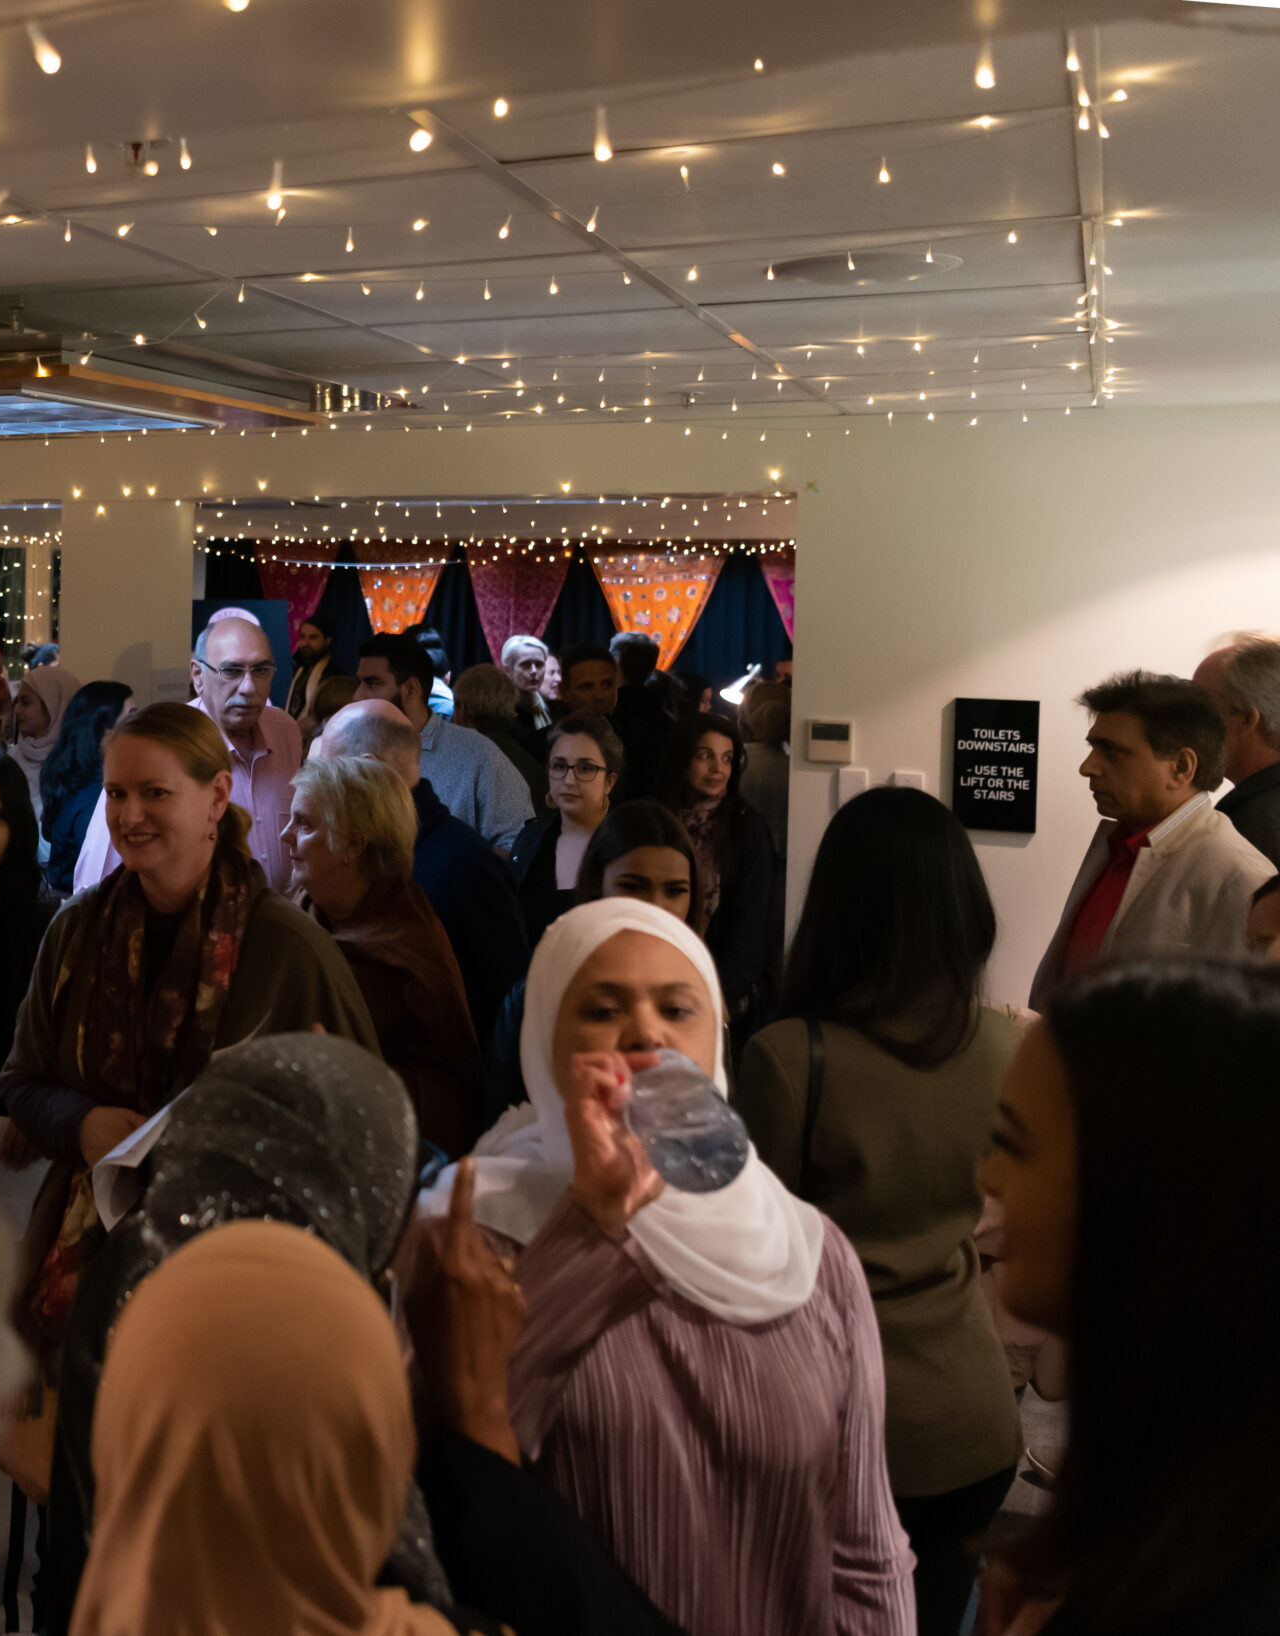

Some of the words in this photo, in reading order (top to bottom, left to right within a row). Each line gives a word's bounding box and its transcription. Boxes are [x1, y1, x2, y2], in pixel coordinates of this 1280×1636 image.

[973, 728, 1021, 740] TOILETS
[958, 740, 1035, 753] DOWNSTAIRS
[974, 765, 997, 775] USE
[1001, 766, 1024, 777] THE
[960, 776, 985, 787] LIFT
[987, 778, 1003, 788] OR
[1007, 779, 1030, 790] THE
[973, 789, 1015, 801] STAIRS
